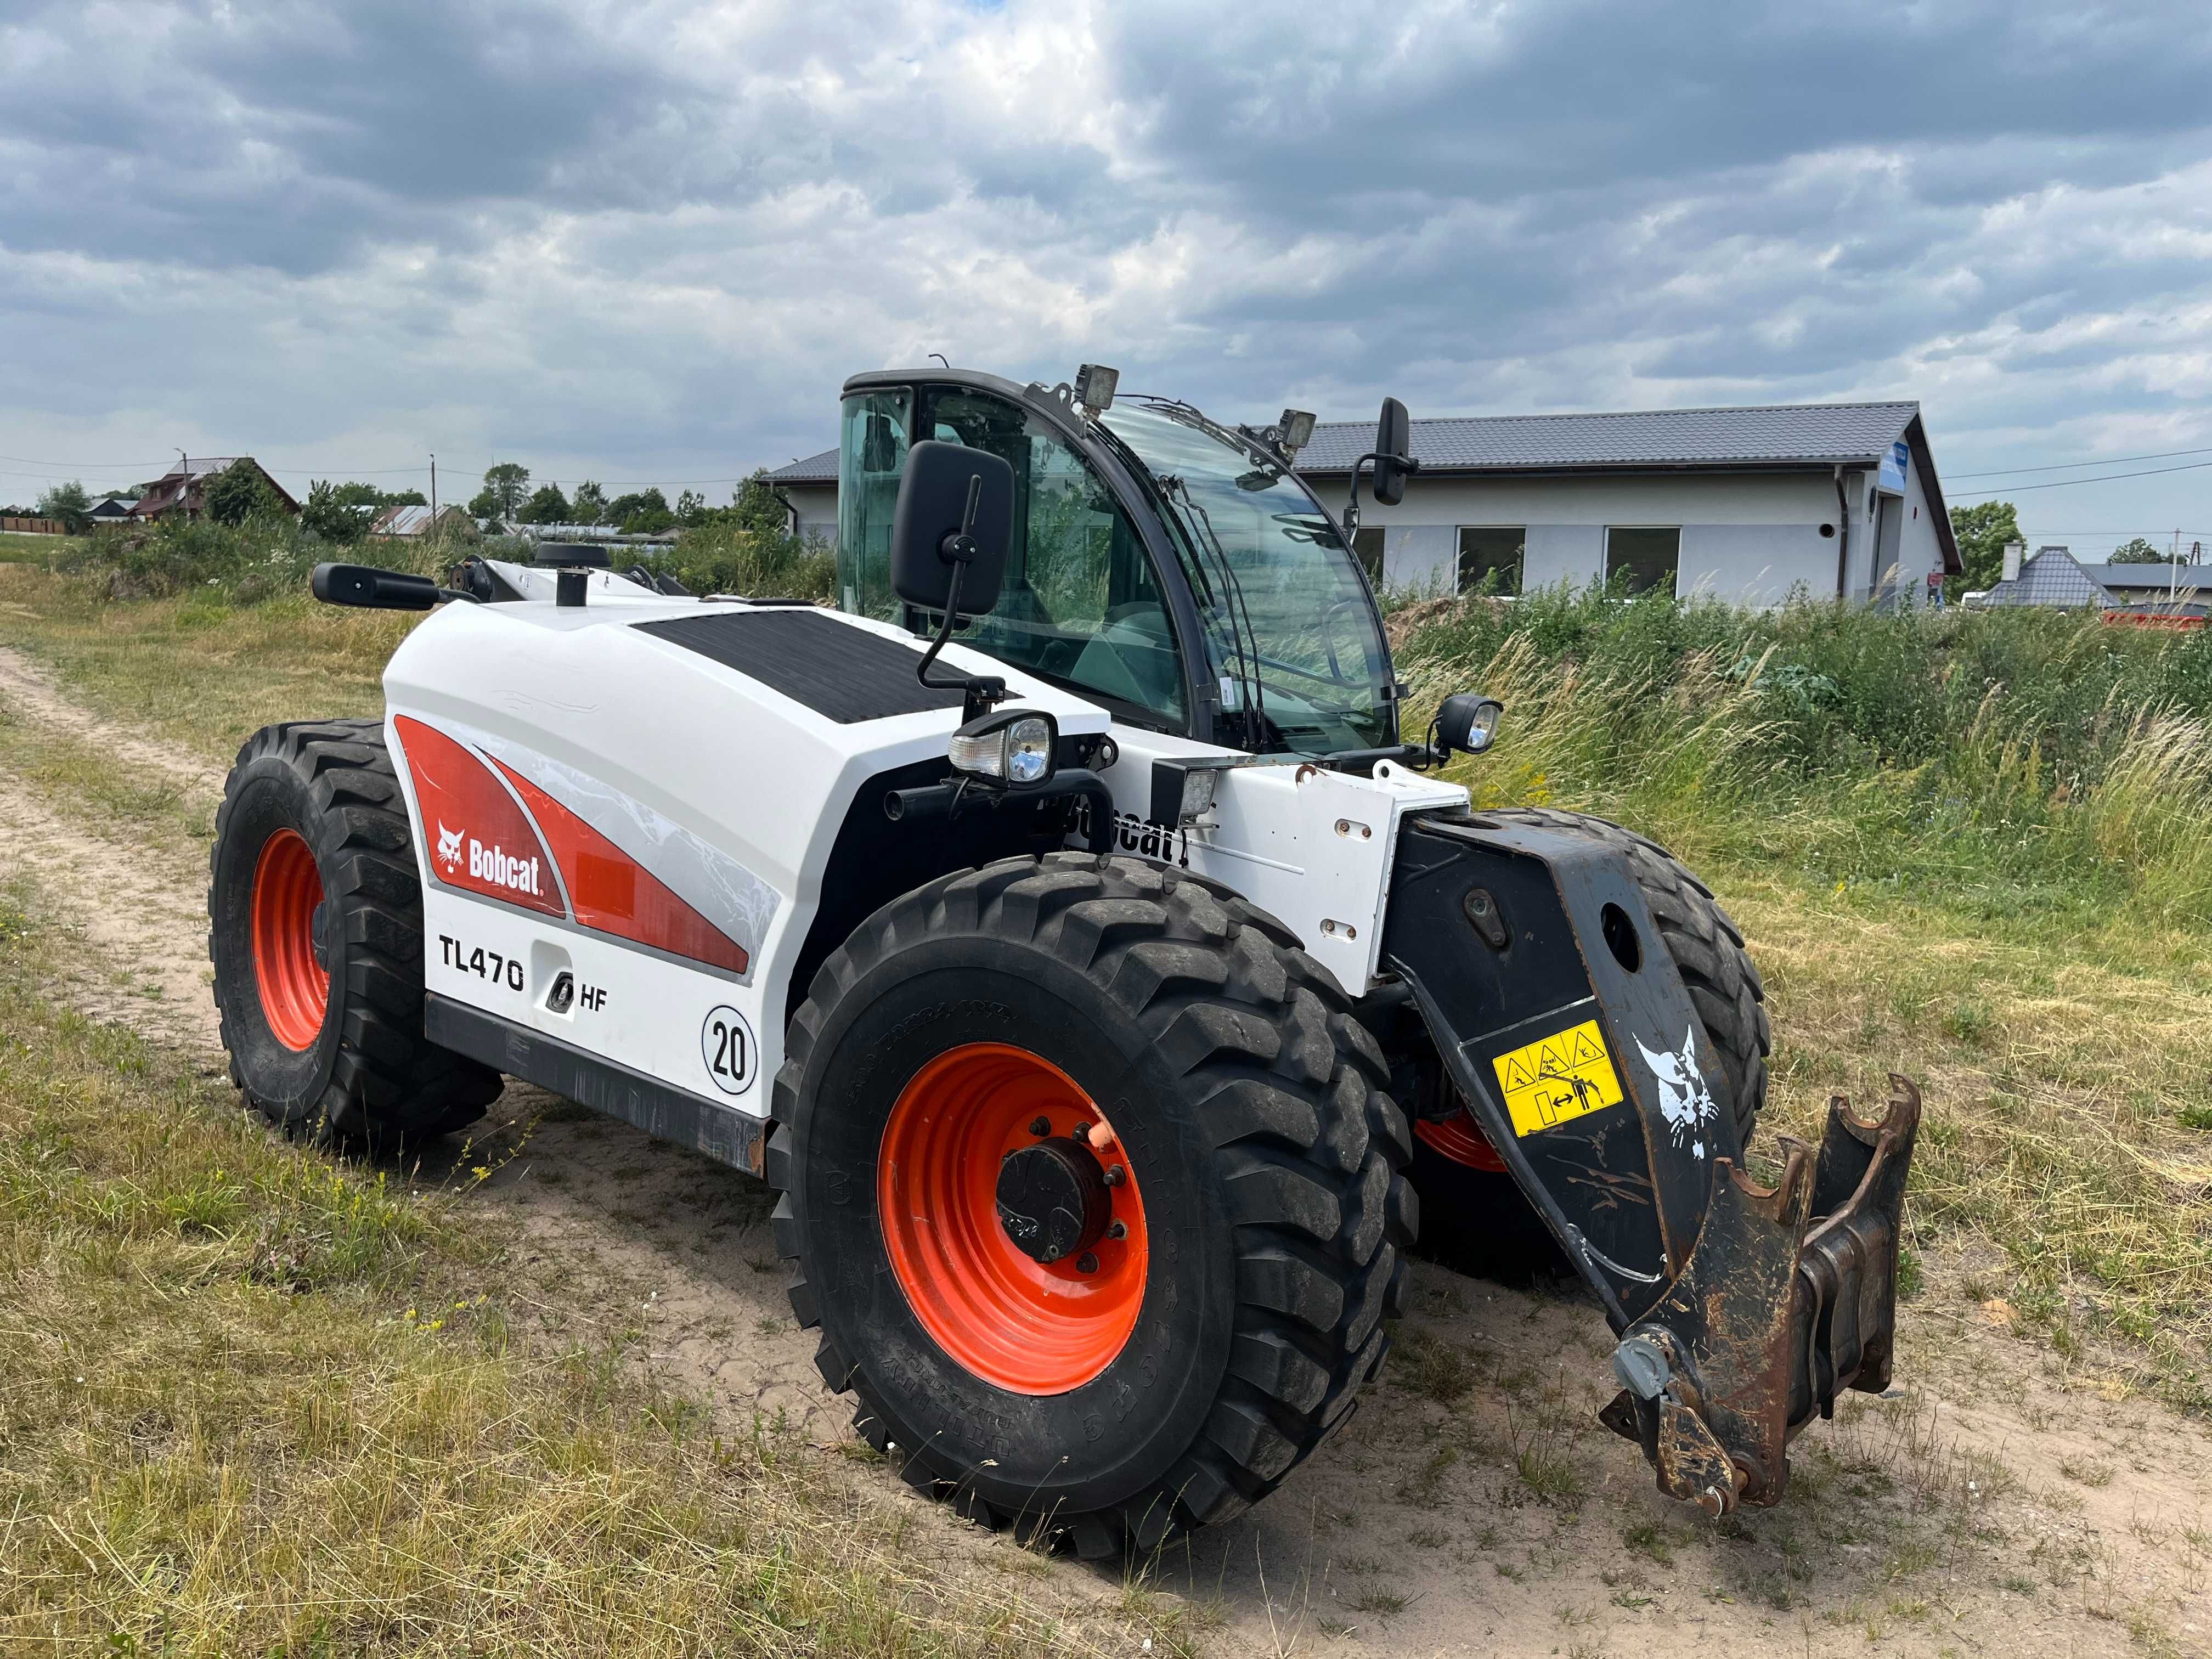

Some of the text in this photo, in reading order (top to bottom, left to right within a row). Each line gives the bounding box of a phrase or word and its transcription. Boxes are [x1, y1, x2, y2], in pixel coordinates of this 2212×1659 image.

[470, 838, 539, 896] Bobcat
[439, 934, 607, 1012] TL470 HF
[713, 1020, 746, 1081] 20
